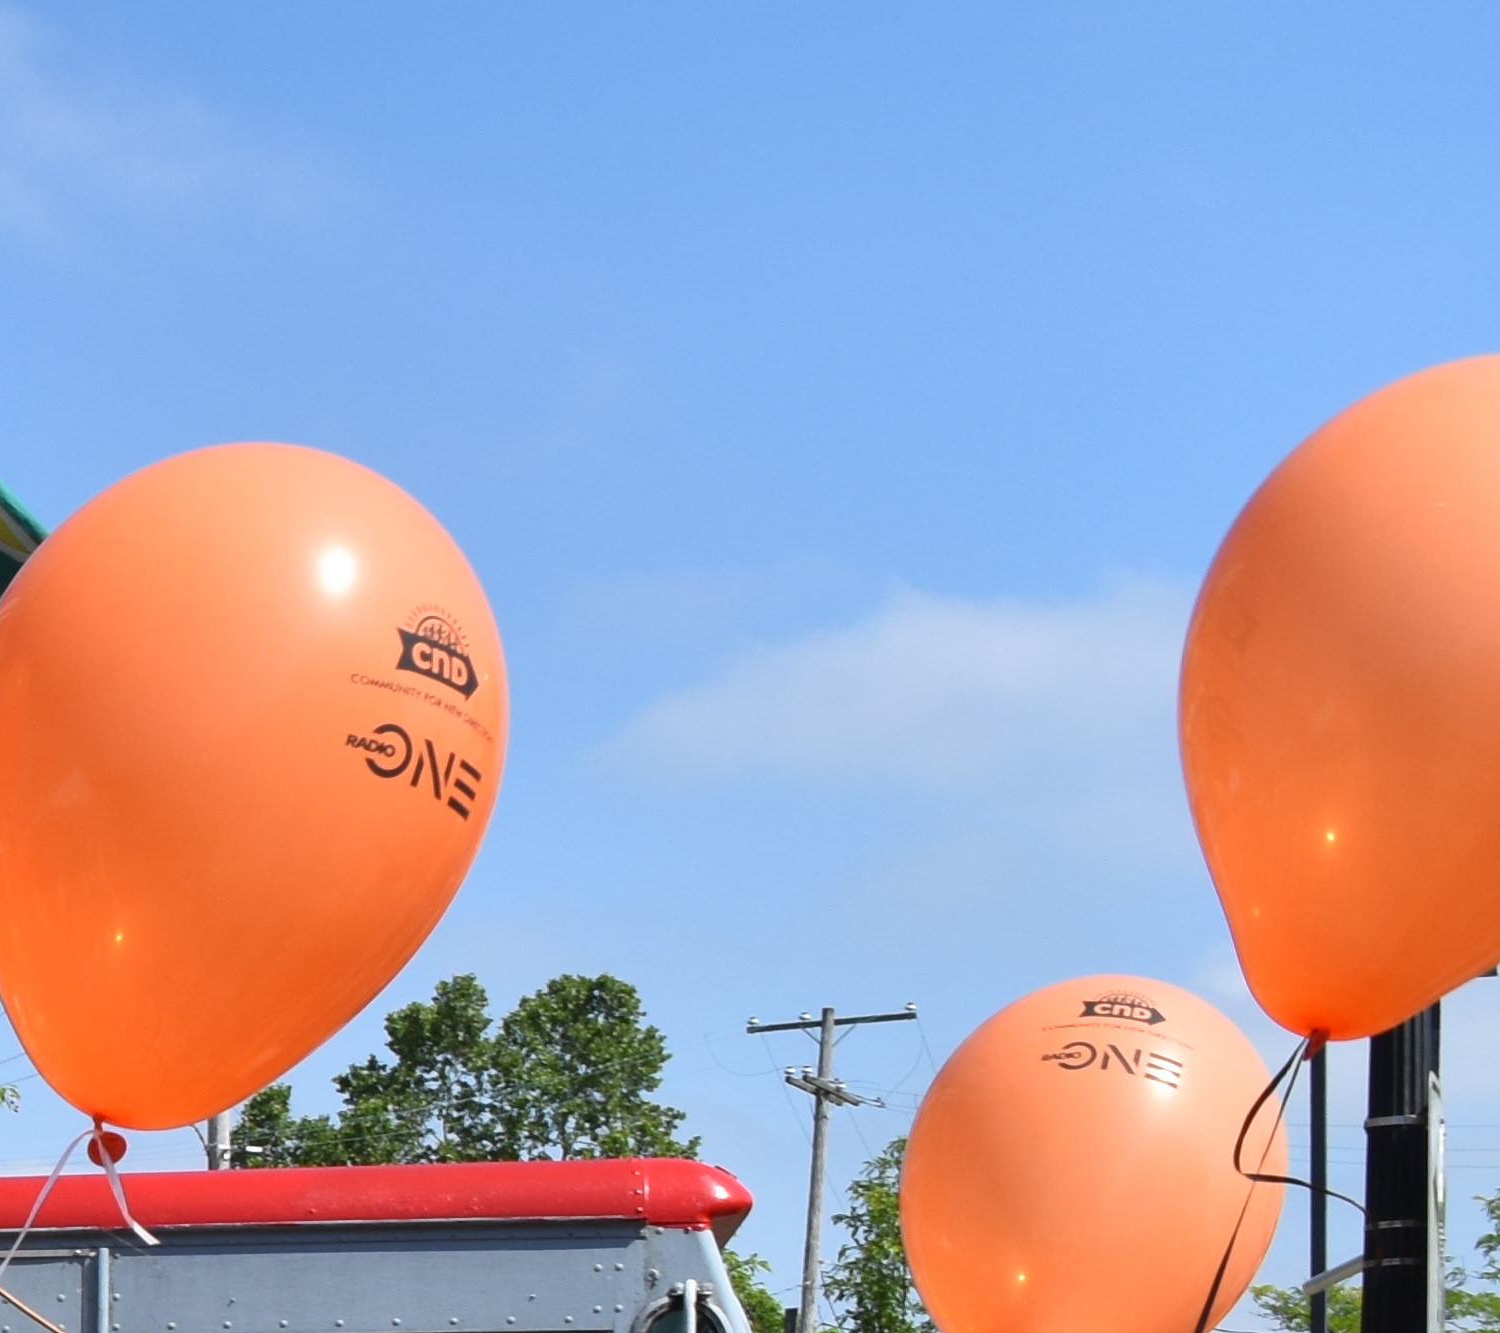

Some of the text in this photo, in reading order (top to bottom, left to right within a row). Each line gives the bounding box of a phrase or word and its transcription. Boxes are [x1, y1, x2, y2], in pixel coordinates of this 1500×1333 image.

[411, 643, 469, 688] CND
[345, 733, 396, 758] RADIO
[365, 723, 482, 821] ONE
[1092, 1003, 1152, 1021] CND
[1057, 1041, 1183, 1089] ONE
